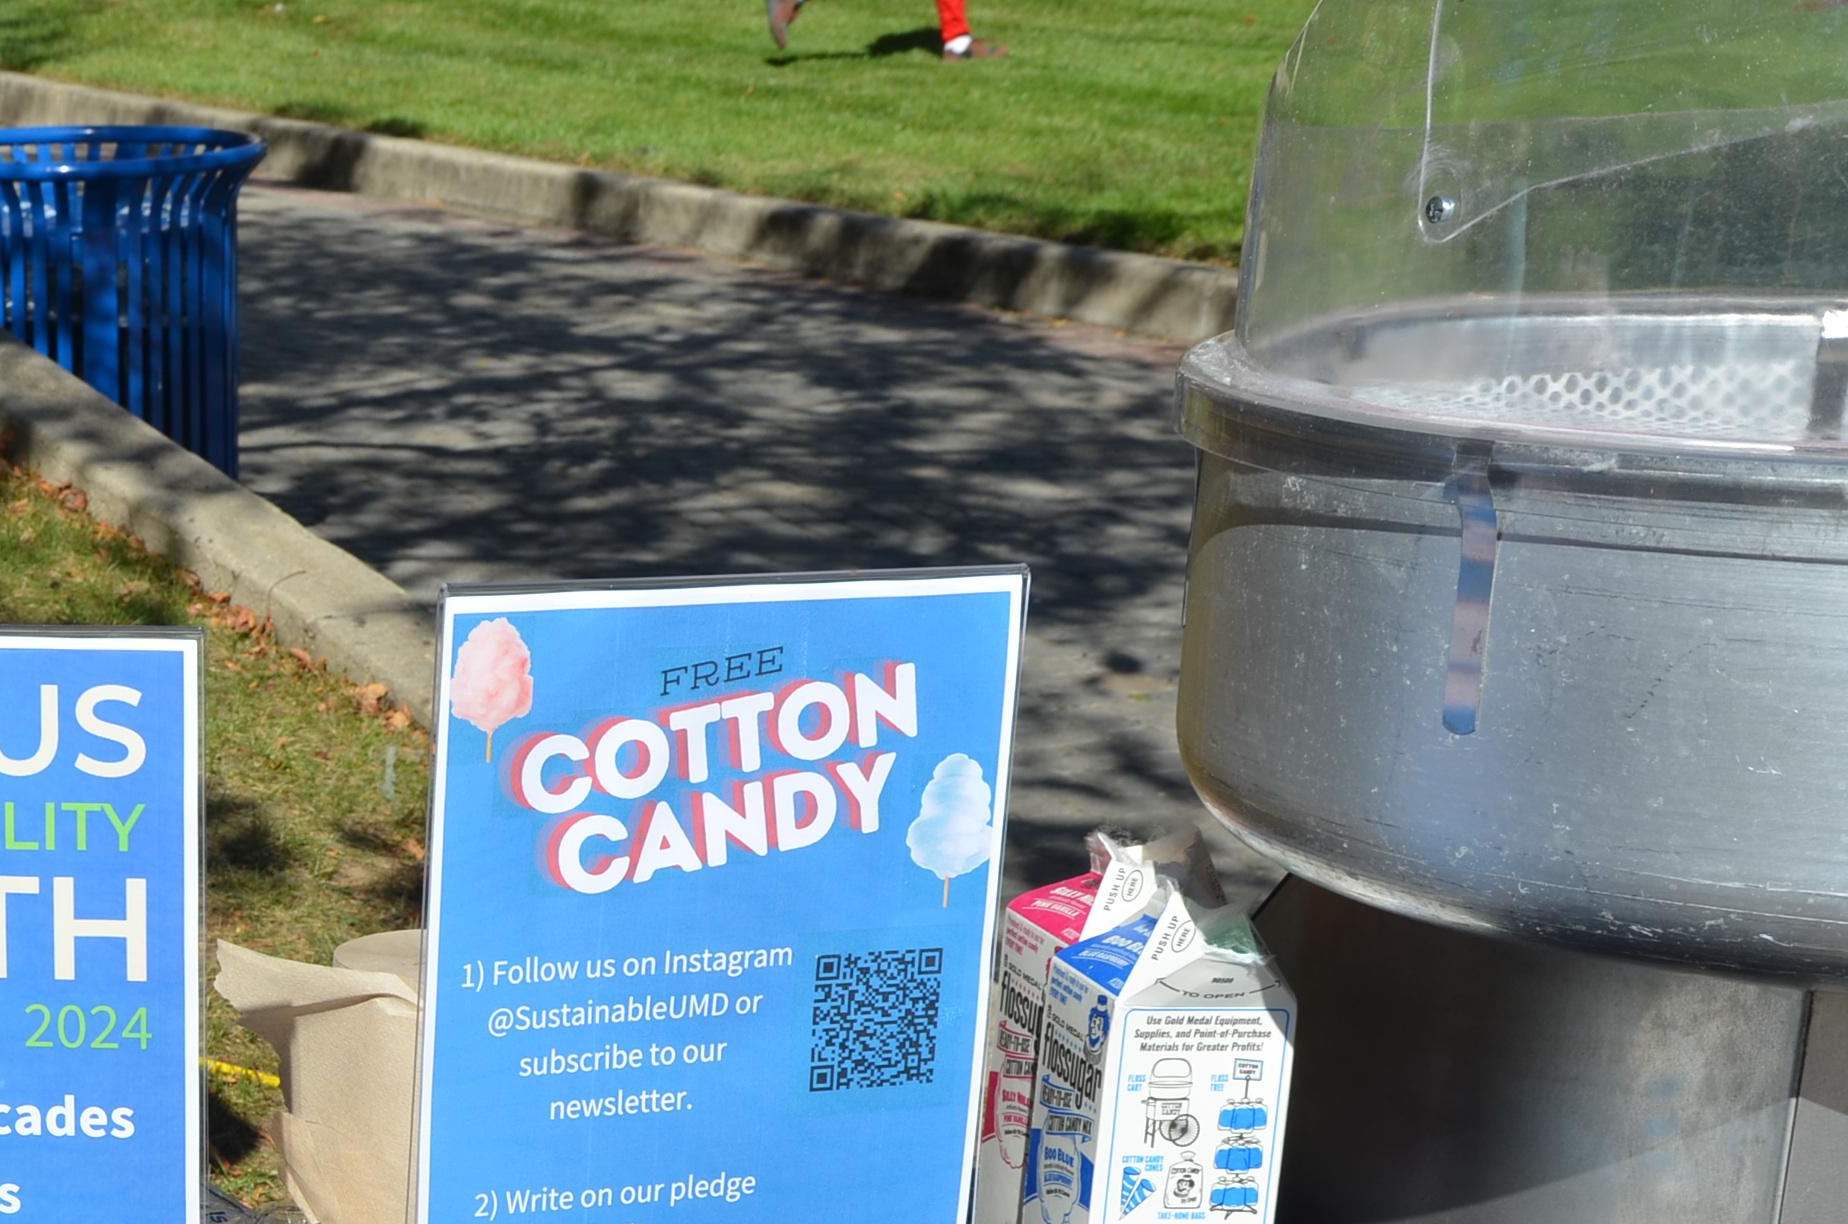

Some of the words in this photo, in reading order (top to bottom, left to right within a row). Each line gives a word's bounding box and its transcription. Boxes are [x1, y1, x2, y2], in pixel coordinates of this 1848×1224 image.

[660, 645, 785, 697] FREE
[511, 661, 918, 814] COTTON
[548, 751, 896, 894] CANDY
[1104, 884, 1120, 912] PUSH
[1117, 867, 1126, 882] UP
[1152, 932, 1170, 961] PUSH
[1168, 915, 1179, 930] UP
[1176, 925, 1192, 948] HERE
[461, 960, 485, 993] 1)
[493, 956, 579, 986] Follow
[586, 959, 616, 979] us
[623, 956, 657, 977] on
[664, 947, 793, 977] Instagram
[24, 1003, 153, 1050] 2024
[488, 992, 729, 1037] @SustainableUMD
[735, 994, 763, 1015] or
[1147, 1016, 1162, 1025] Use
[1164, 1016, 1184, 1025] Gold
[1187, 1016, 1212, 1025] Medal
[1175, 1030, 1192, 1038] and
[519, 1043, 643, 1077] subscribe
[650, 1043, 676, 1066] to
[683, 1042, 728, 1063] our
[1042, 1021, 1102, 1111] flossugar
[1140, 1042, 1179, 1051] Materials
[1182, 1042, 1194, 1051] for
[1196, 1042, 1229, 1051] Greater
[1232, 1042, 1264, 1051] Profits!
[550, 1089, 693, 1120] newsletter.
[473, 1190, 498, 1221] 2)
[505, 1187, 574, 1215] Write
[580, 1187, 613, 1208] on
[620, 1182, 664, 1204] our
[670, 1172, 757, 1207] pledge
